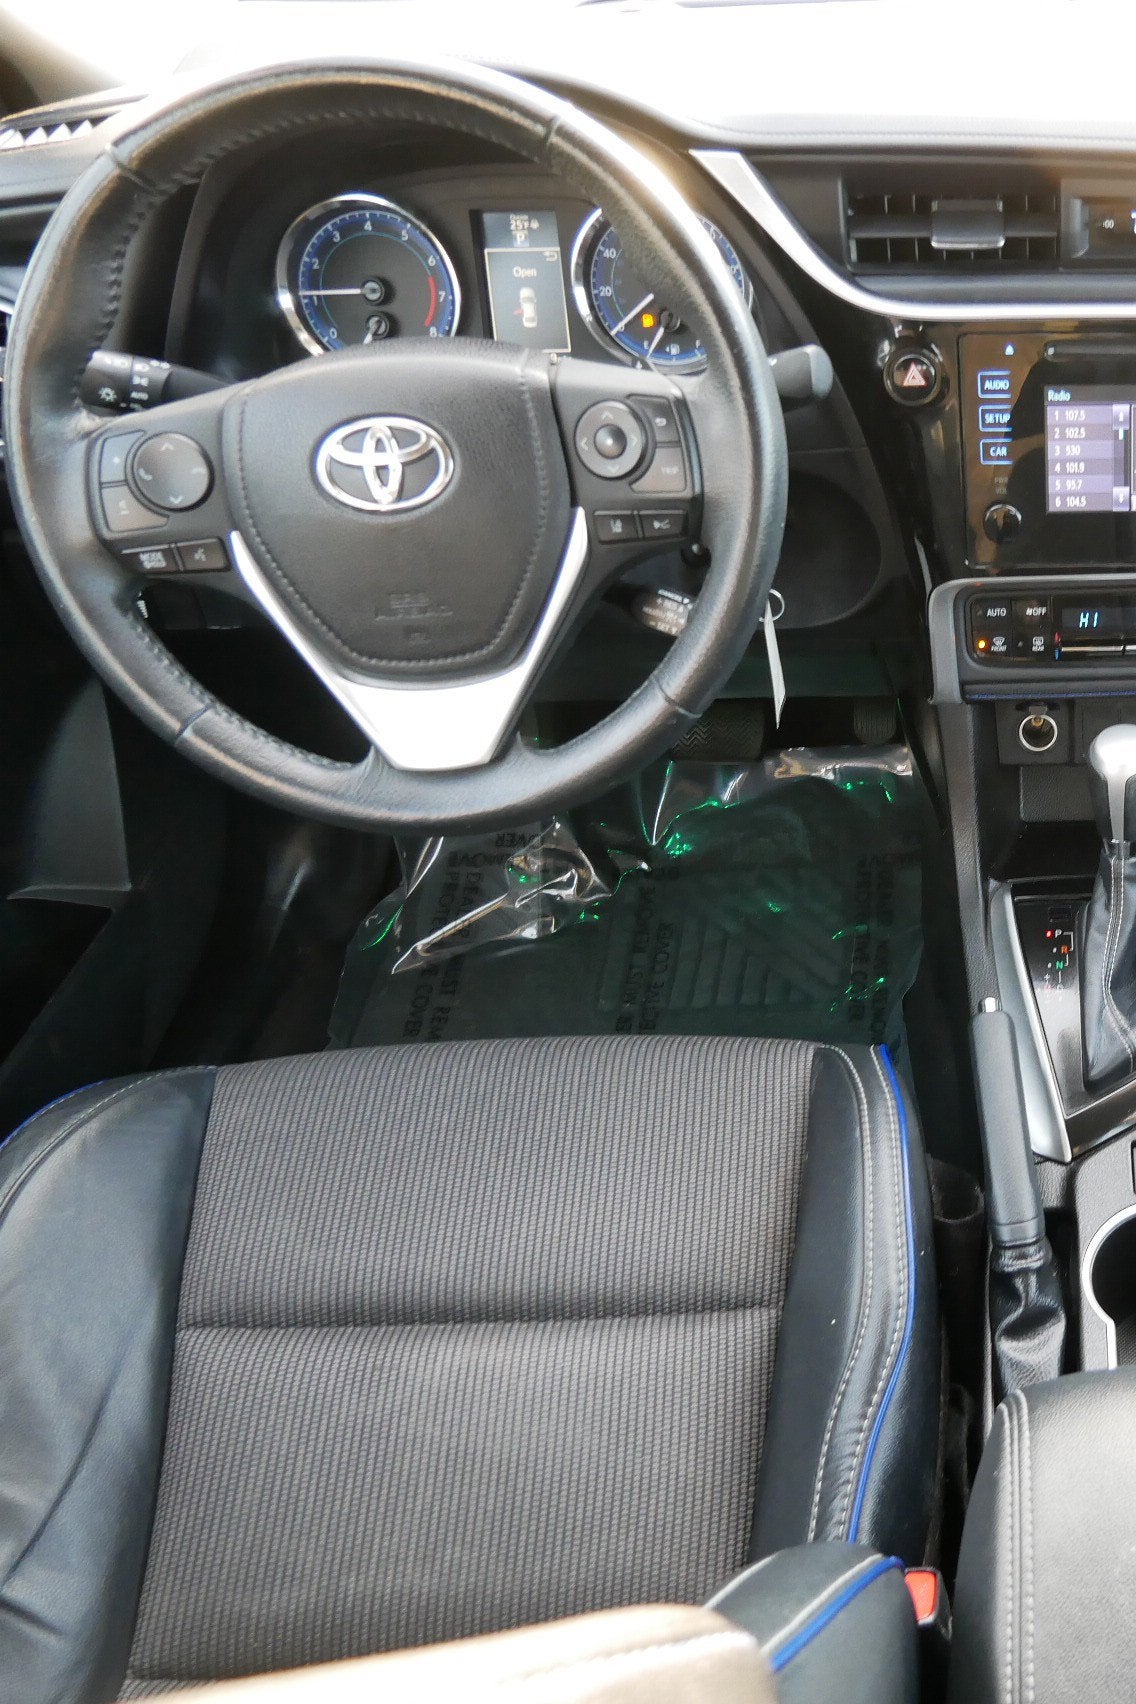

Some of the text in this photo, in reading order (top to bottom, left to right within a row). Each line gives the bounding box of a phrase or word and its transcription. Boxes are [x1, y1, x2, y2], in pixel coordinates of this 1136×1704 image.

[363, 219, 373, 231] 4
[332, 230, 341, 243] 3
[401, 229, 410, 241] 5
[603, 248, 617, 259] 40
[312, 258, 321, 270] 2
[428, 255, 437, 267] 6
[512, 266, 538, 278] Open
[438, 290, 447, 302] 7
[599, 285, 612, 296] 20
[329, 327, 338, 339] 0
[429, 326, 438, 338] 8
[984, 379, 1010, 391] AUDIO
[1047, 389, 1071, 402] Radio
[984, 413, 1011, 424] SETUP
[1054, 427, 1086, 439] 2 102.5
[989, 446, 1008, 457] CAR
[1054, 445, 1061, 456] 3
[1054, 462, 1086, 473] 4 101.9
[1055, 480, 1062, 491] 5
[1055, 497, 1062, 508] 6
[987, 607, 1007, 617] AUTO
[1054, 928, 1063, 938] P
[1055, 960, 1065, 970] N
